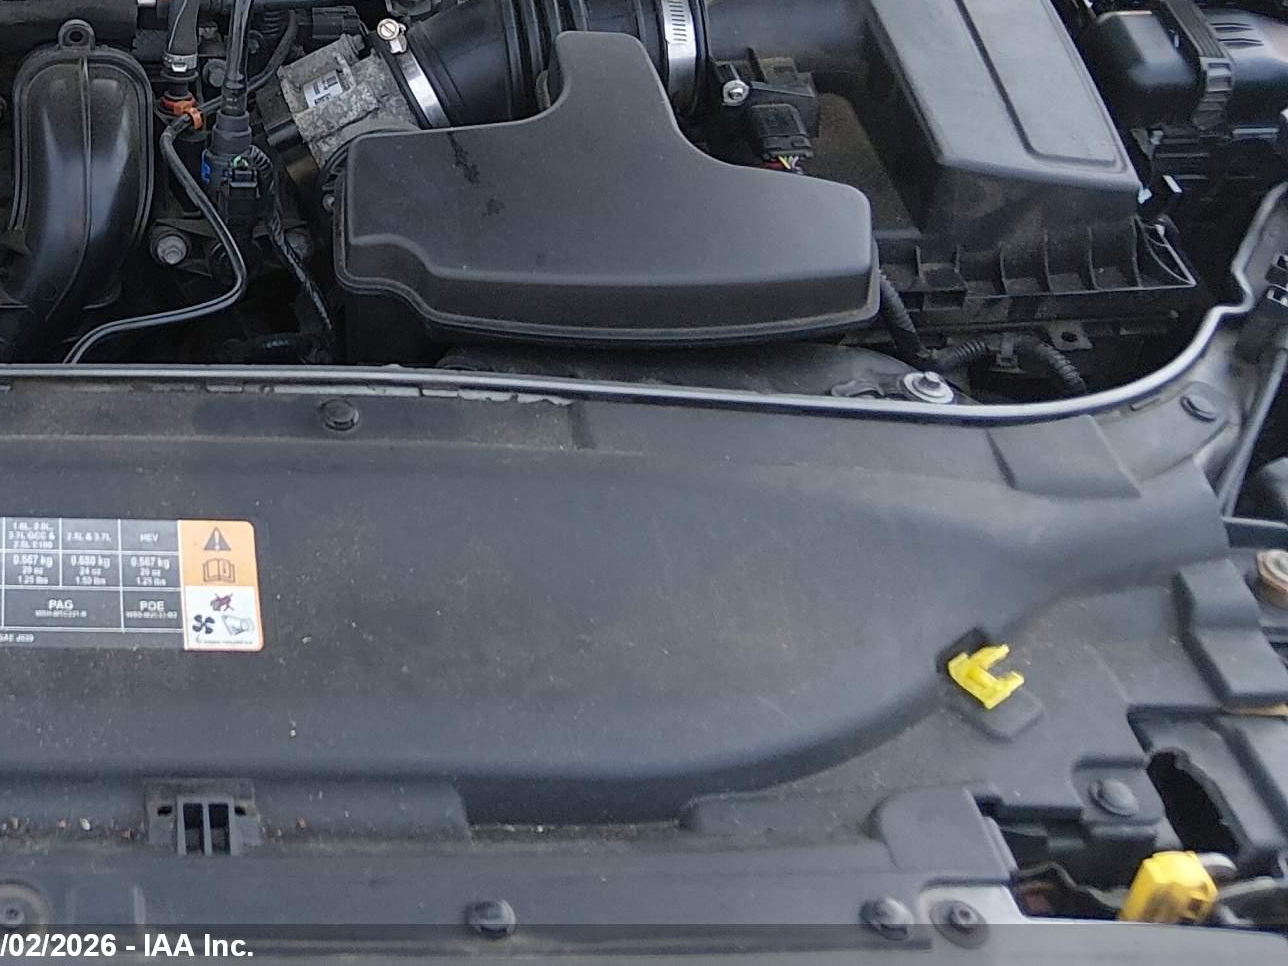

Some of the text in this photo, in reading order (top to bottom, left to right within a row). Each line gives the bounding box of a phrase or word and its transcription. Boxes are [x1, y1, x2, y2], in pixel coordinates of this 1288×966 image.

[85, 532, 92, 542] &
[140, 533, 159, 543] HEV
[13, 554, 53, 569] 0.567 kg
[98, 554, 110, 569] kg
[157, 555, 170, 571] kg
[22, 565, 44, 575] 20 oz
[79, 566, 102, 576] 24 oz
[139, 567, 161, 577] 20 oz
[48, 599, 74, 610] PAG
[139, 600, 165, 612] POE
